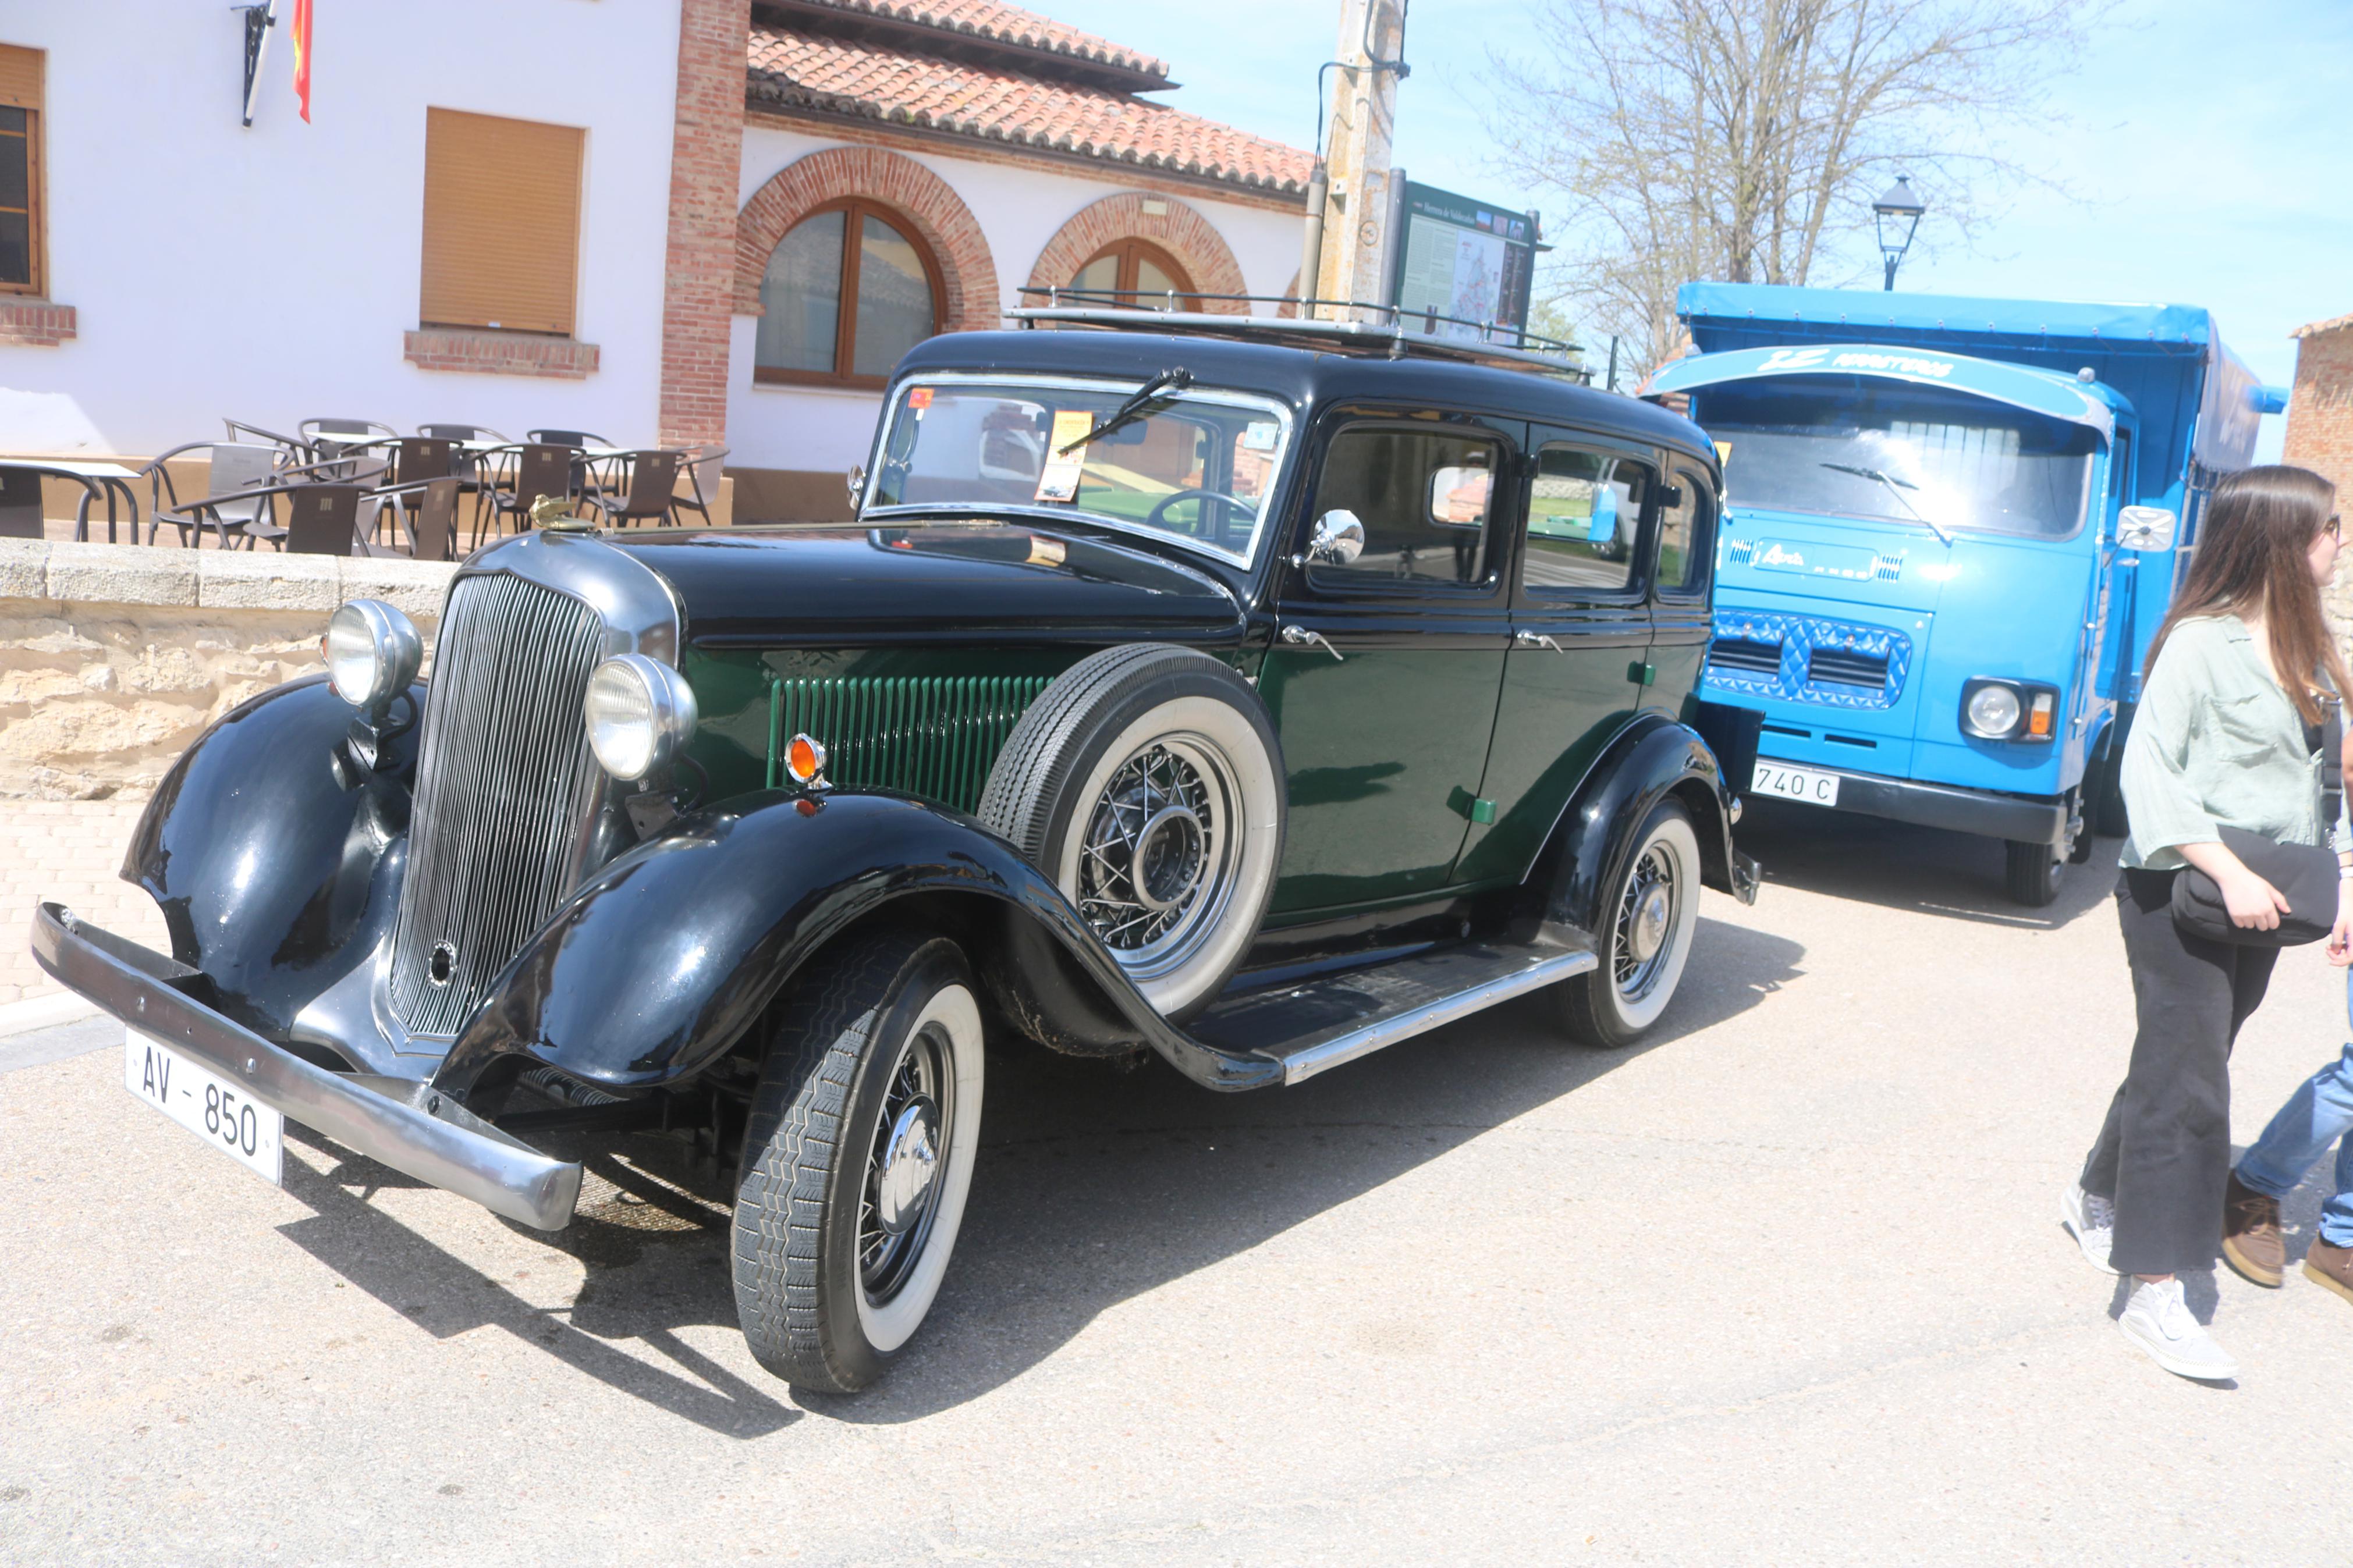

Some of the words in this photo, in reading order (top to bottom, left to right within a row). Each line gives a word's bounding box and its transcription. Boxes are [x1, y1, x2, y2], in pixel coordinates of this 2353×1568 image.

[1443, 207, 1450, 218] de
[1756, 769, 1804, 795] 740
[1816, 780, 1831, 799] C
[143, 1046, 170, 1103] AV
[205, 1083, 257, 1157] 850
